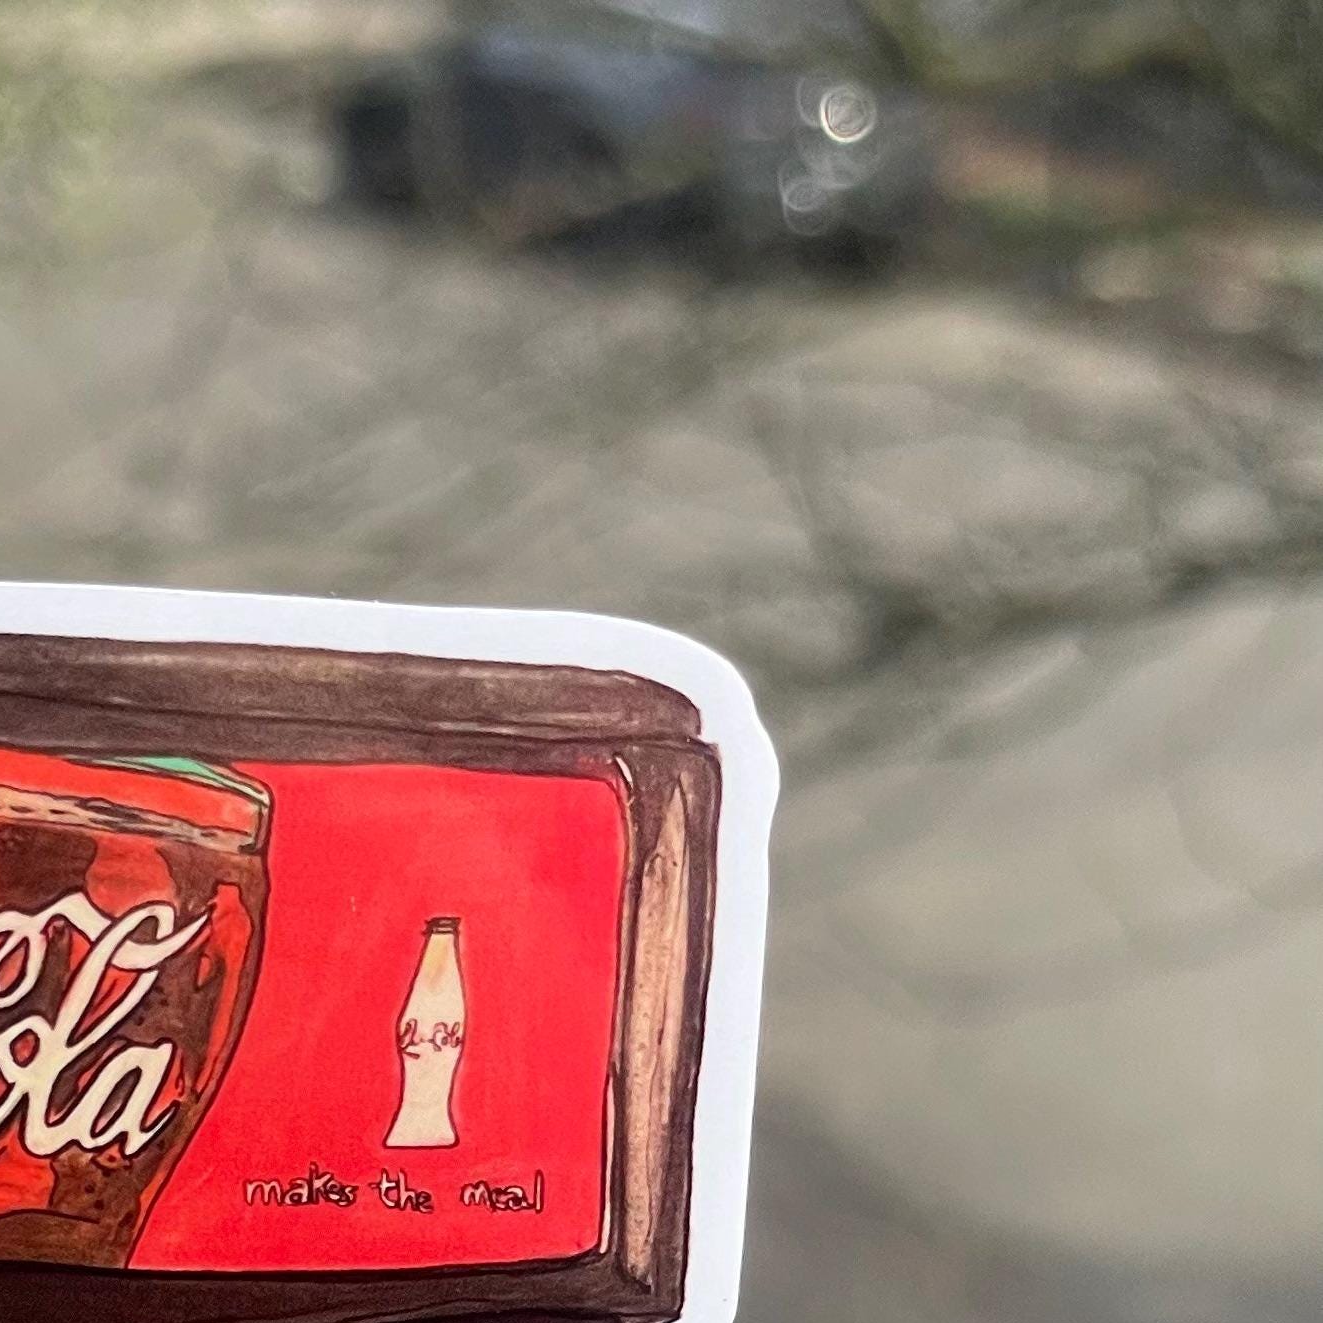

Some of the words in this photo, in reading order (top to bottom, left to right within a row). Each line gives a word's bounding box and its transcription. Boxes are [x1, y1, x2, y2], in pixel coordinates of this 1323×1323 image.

[243, 1161, 359, 1207] makes
[370, 1167, 434, 1213] the
[459, 1169, 545, 1214] meal
